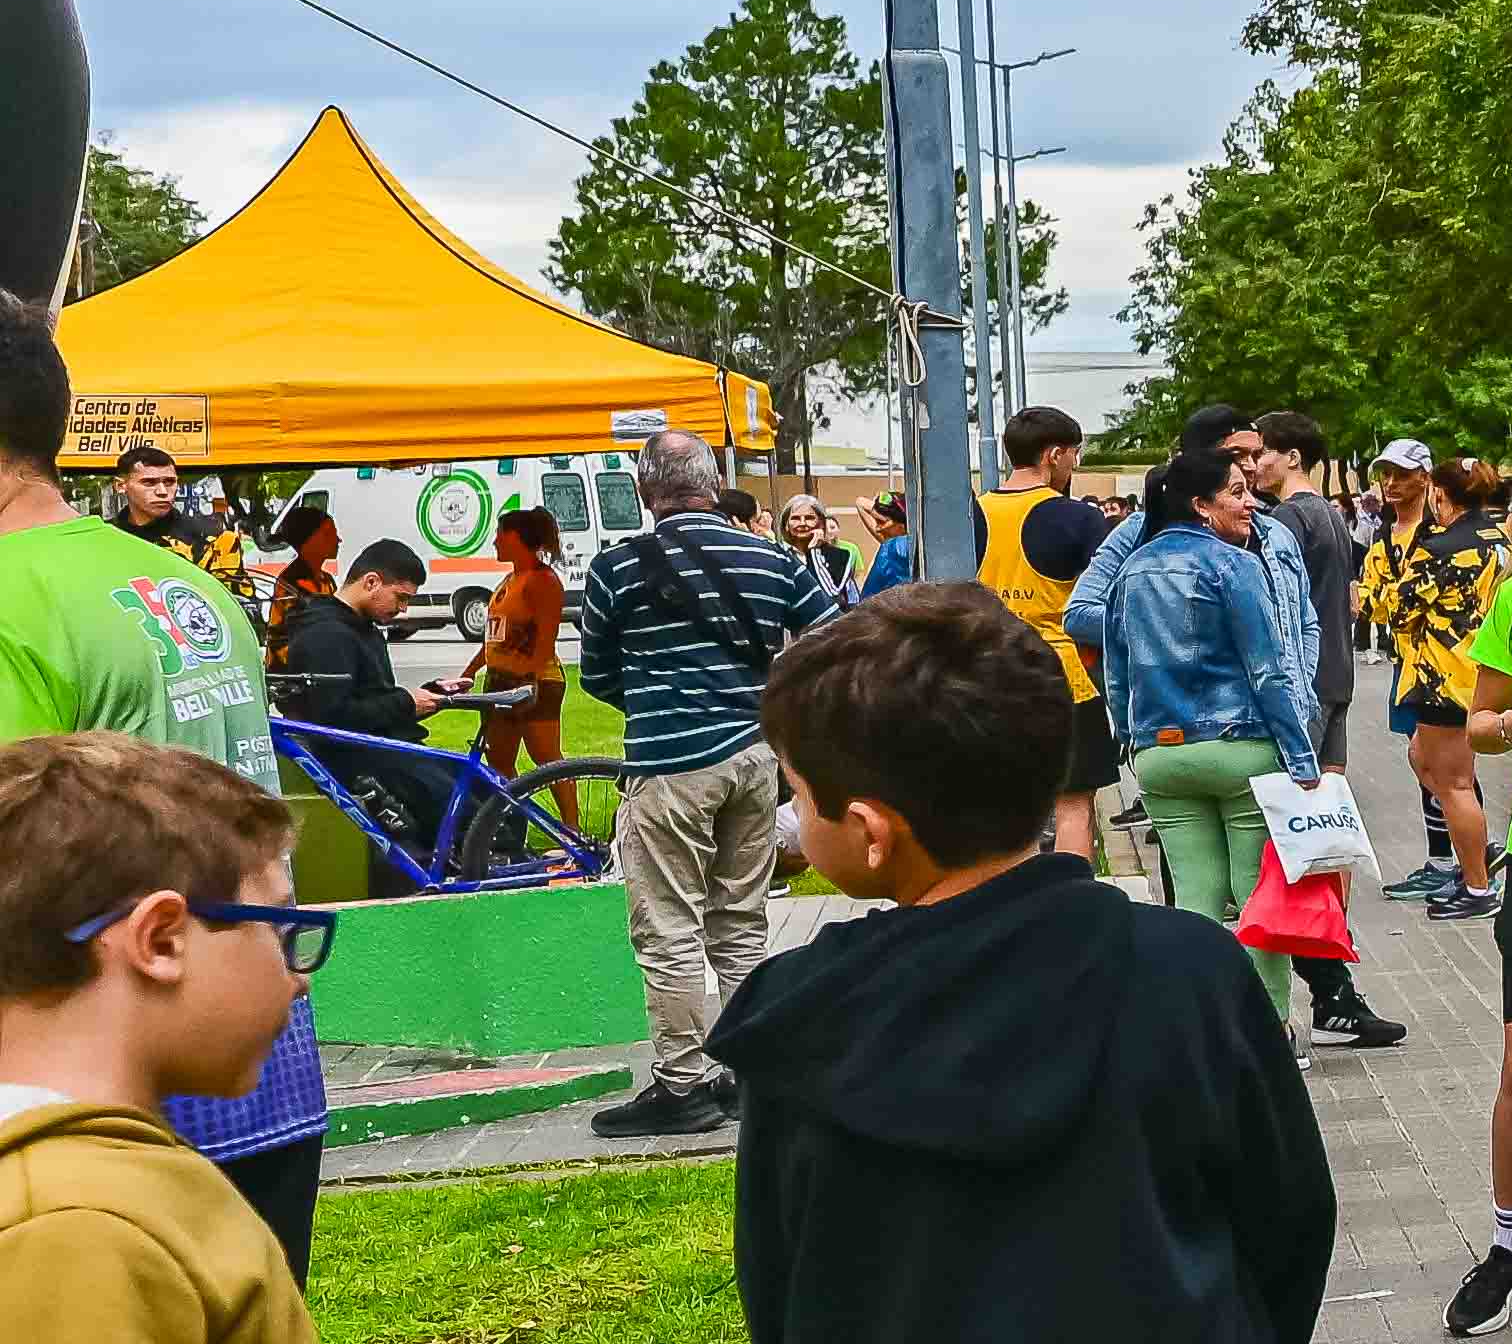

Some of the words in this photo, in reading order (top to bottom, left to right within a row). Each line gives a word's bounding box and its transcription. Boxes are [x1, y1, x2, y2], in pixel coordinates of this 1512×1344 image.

[75, 399, 130, 415] Centro
[135, 399, 156, 415] de
[78, 435, 112, 452] Bell
